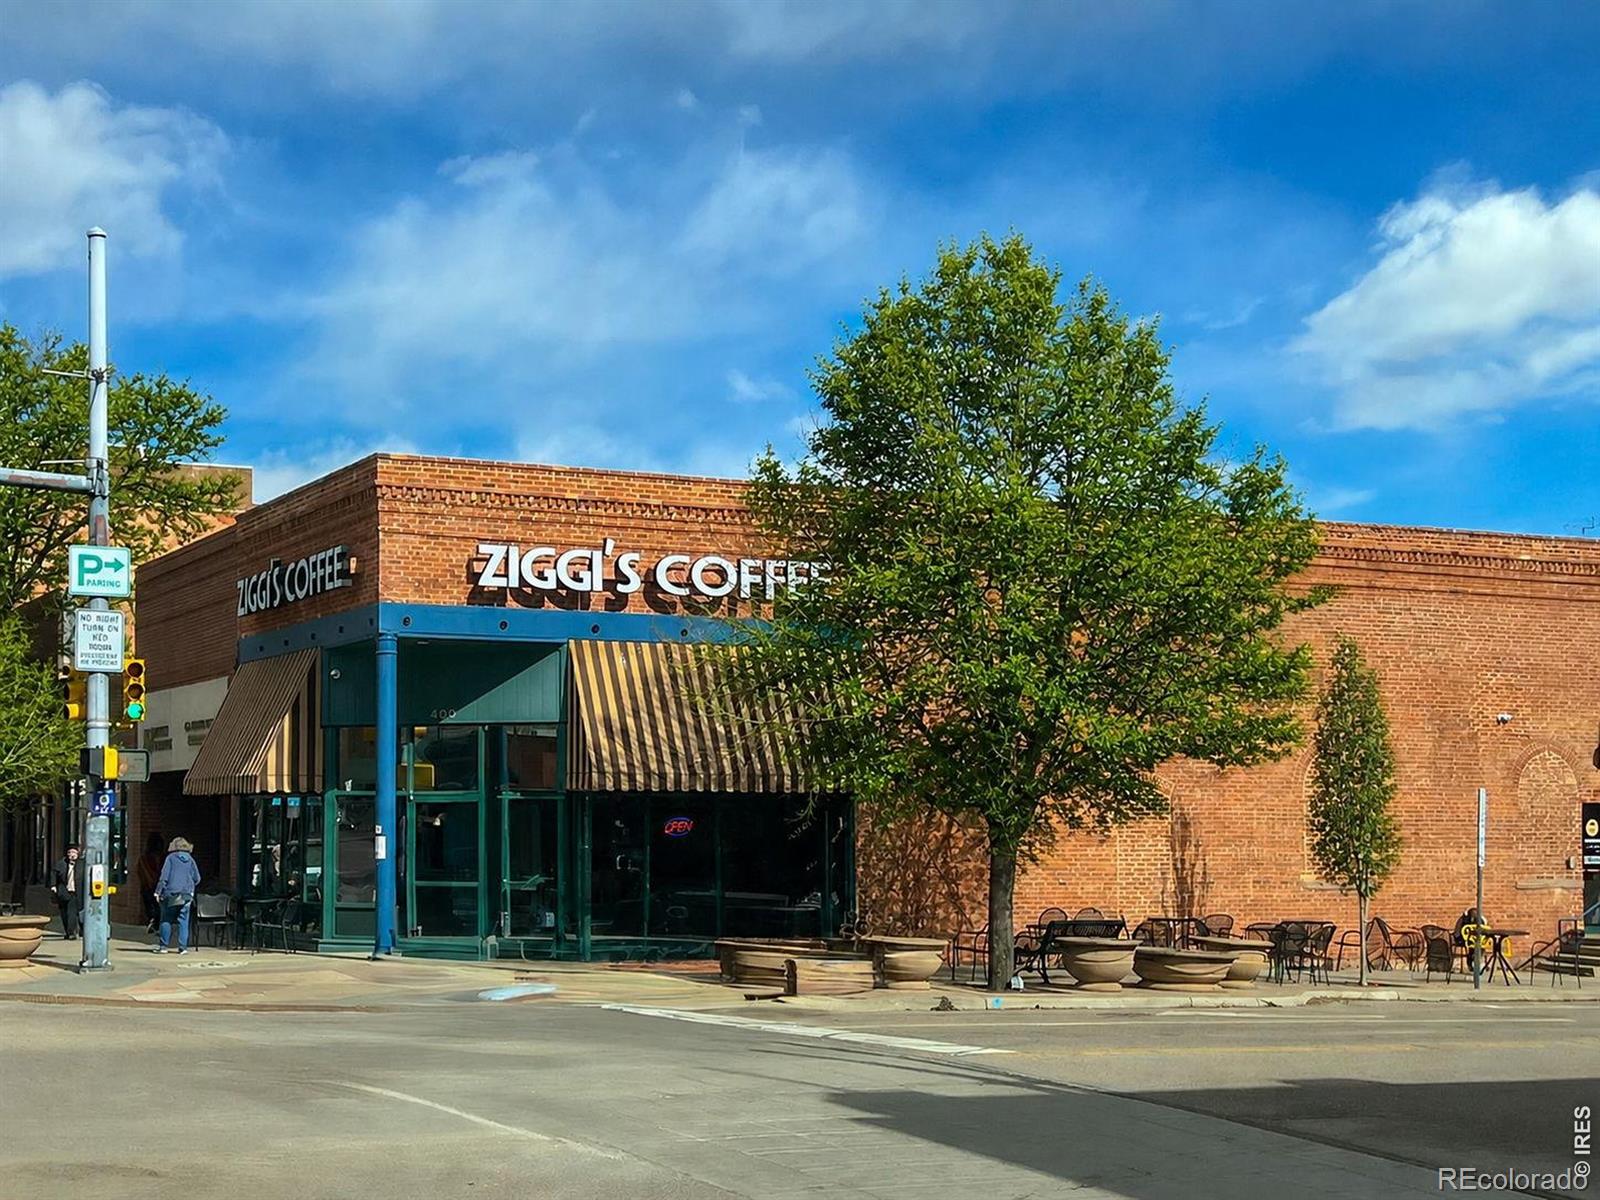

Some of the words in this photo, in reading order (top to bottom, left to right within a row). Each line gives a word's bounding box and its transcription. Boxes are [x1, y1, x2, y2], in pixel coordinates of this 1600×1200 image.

[237, 558, 280, 616] ZIGGI'S
[285, 545, 344, 601] COFFEE
[477, 538, 641, 594] ZIGGI'S
